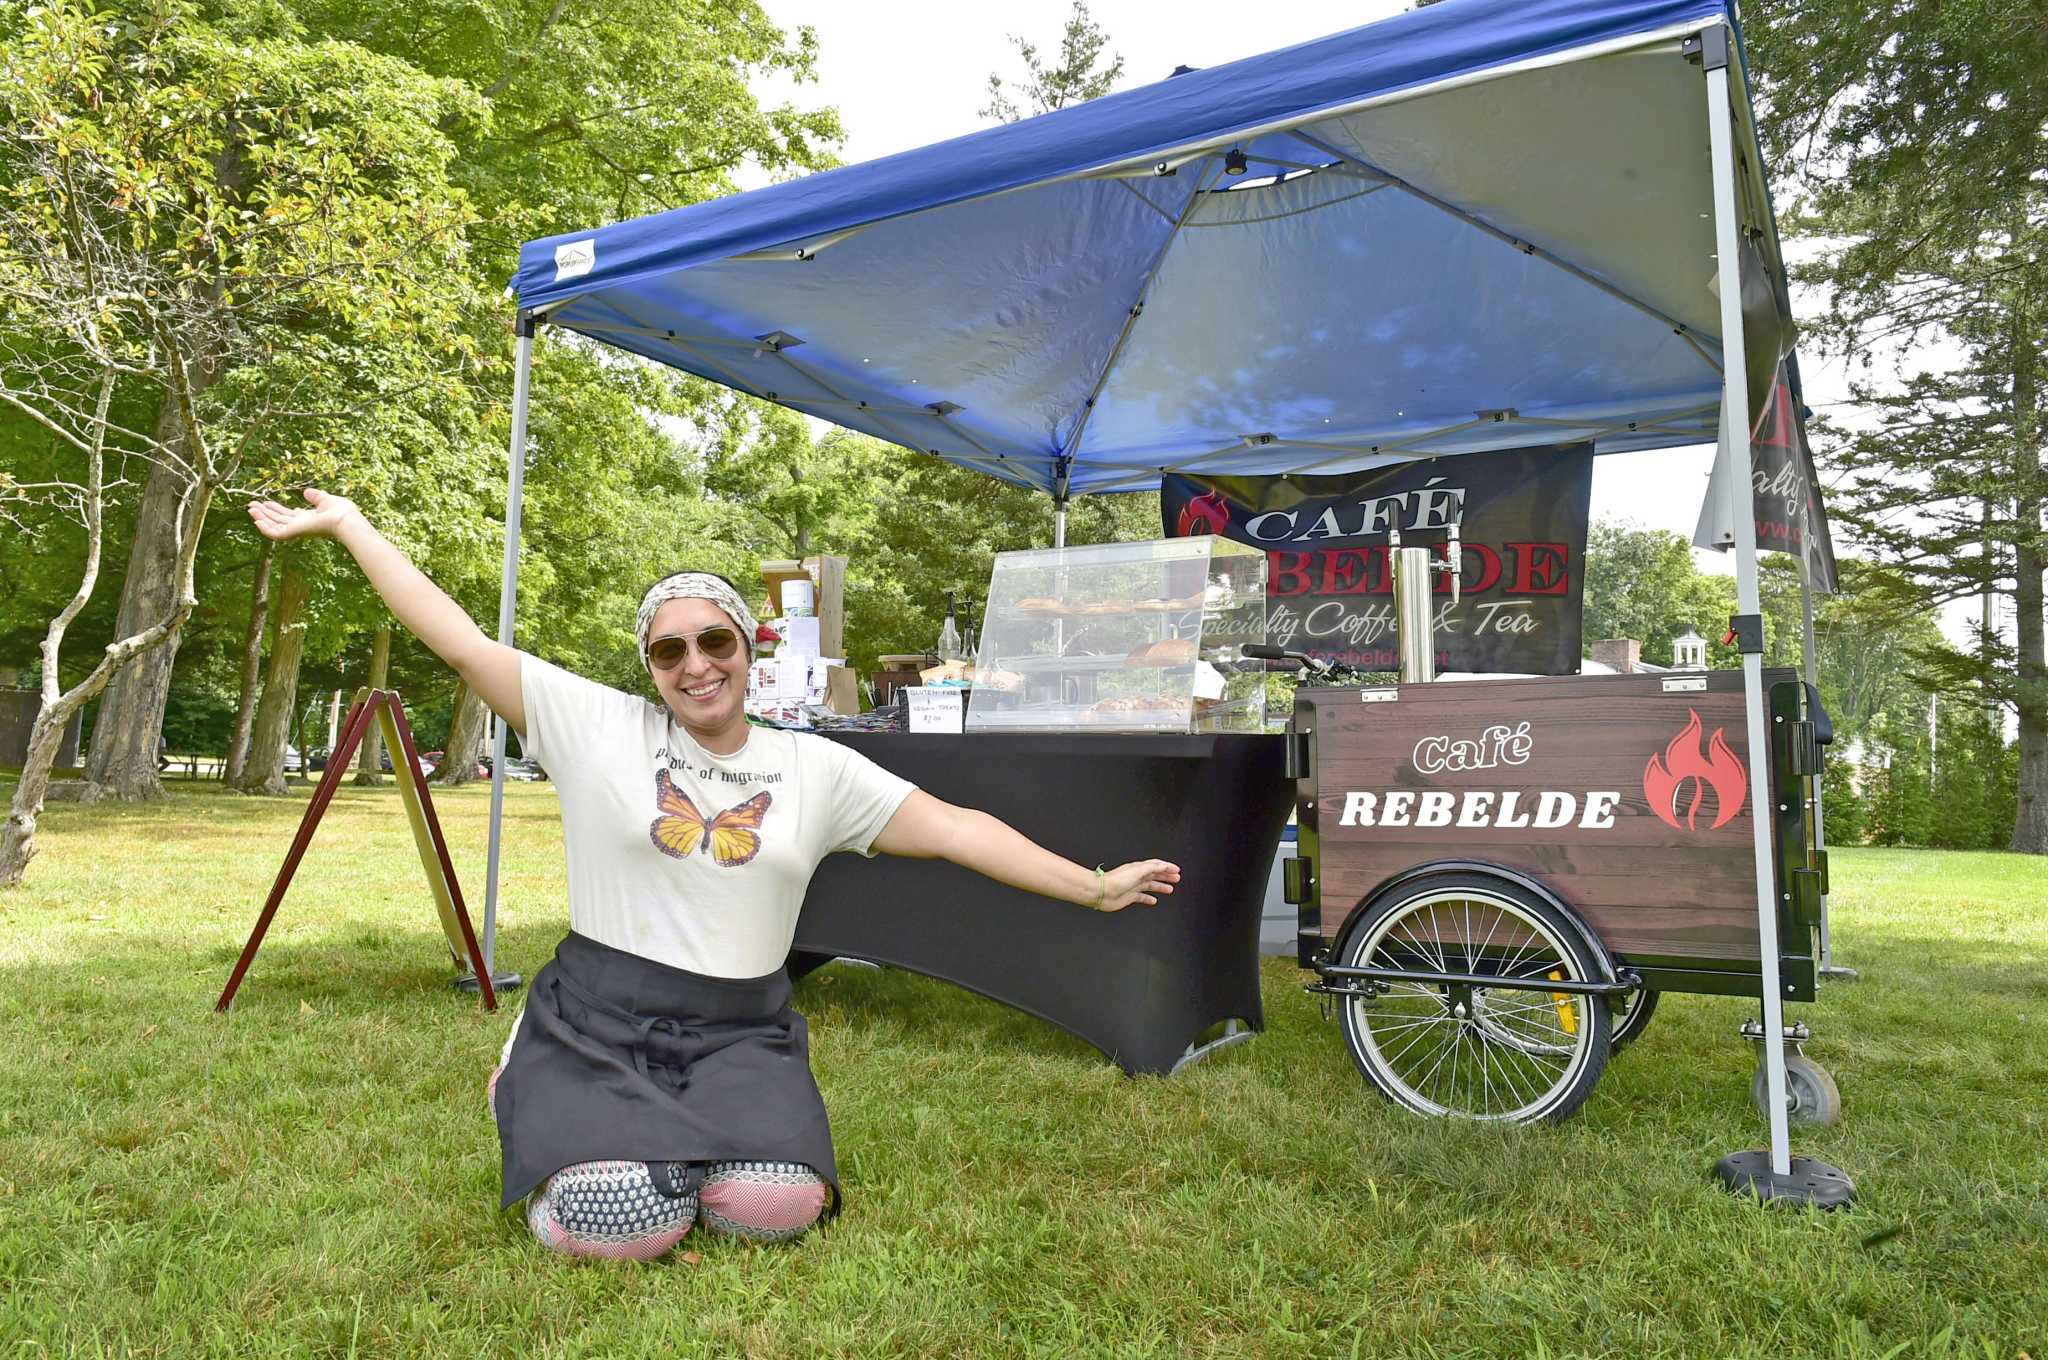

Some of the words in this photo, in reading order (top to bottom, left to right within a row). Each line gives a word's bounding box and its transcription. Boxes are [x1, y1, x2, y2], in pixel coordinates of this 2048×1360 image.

[1244, 477, 1466, 543] CAFÉ
[1304, 601, 1399, 646] Coffe
[1473, 600, 1543, 636] Tea
[1413, 721, 1534, 775] Café
[699, 767, 715, 780] of
[1338, 790, 1621, 829] REBELDE
